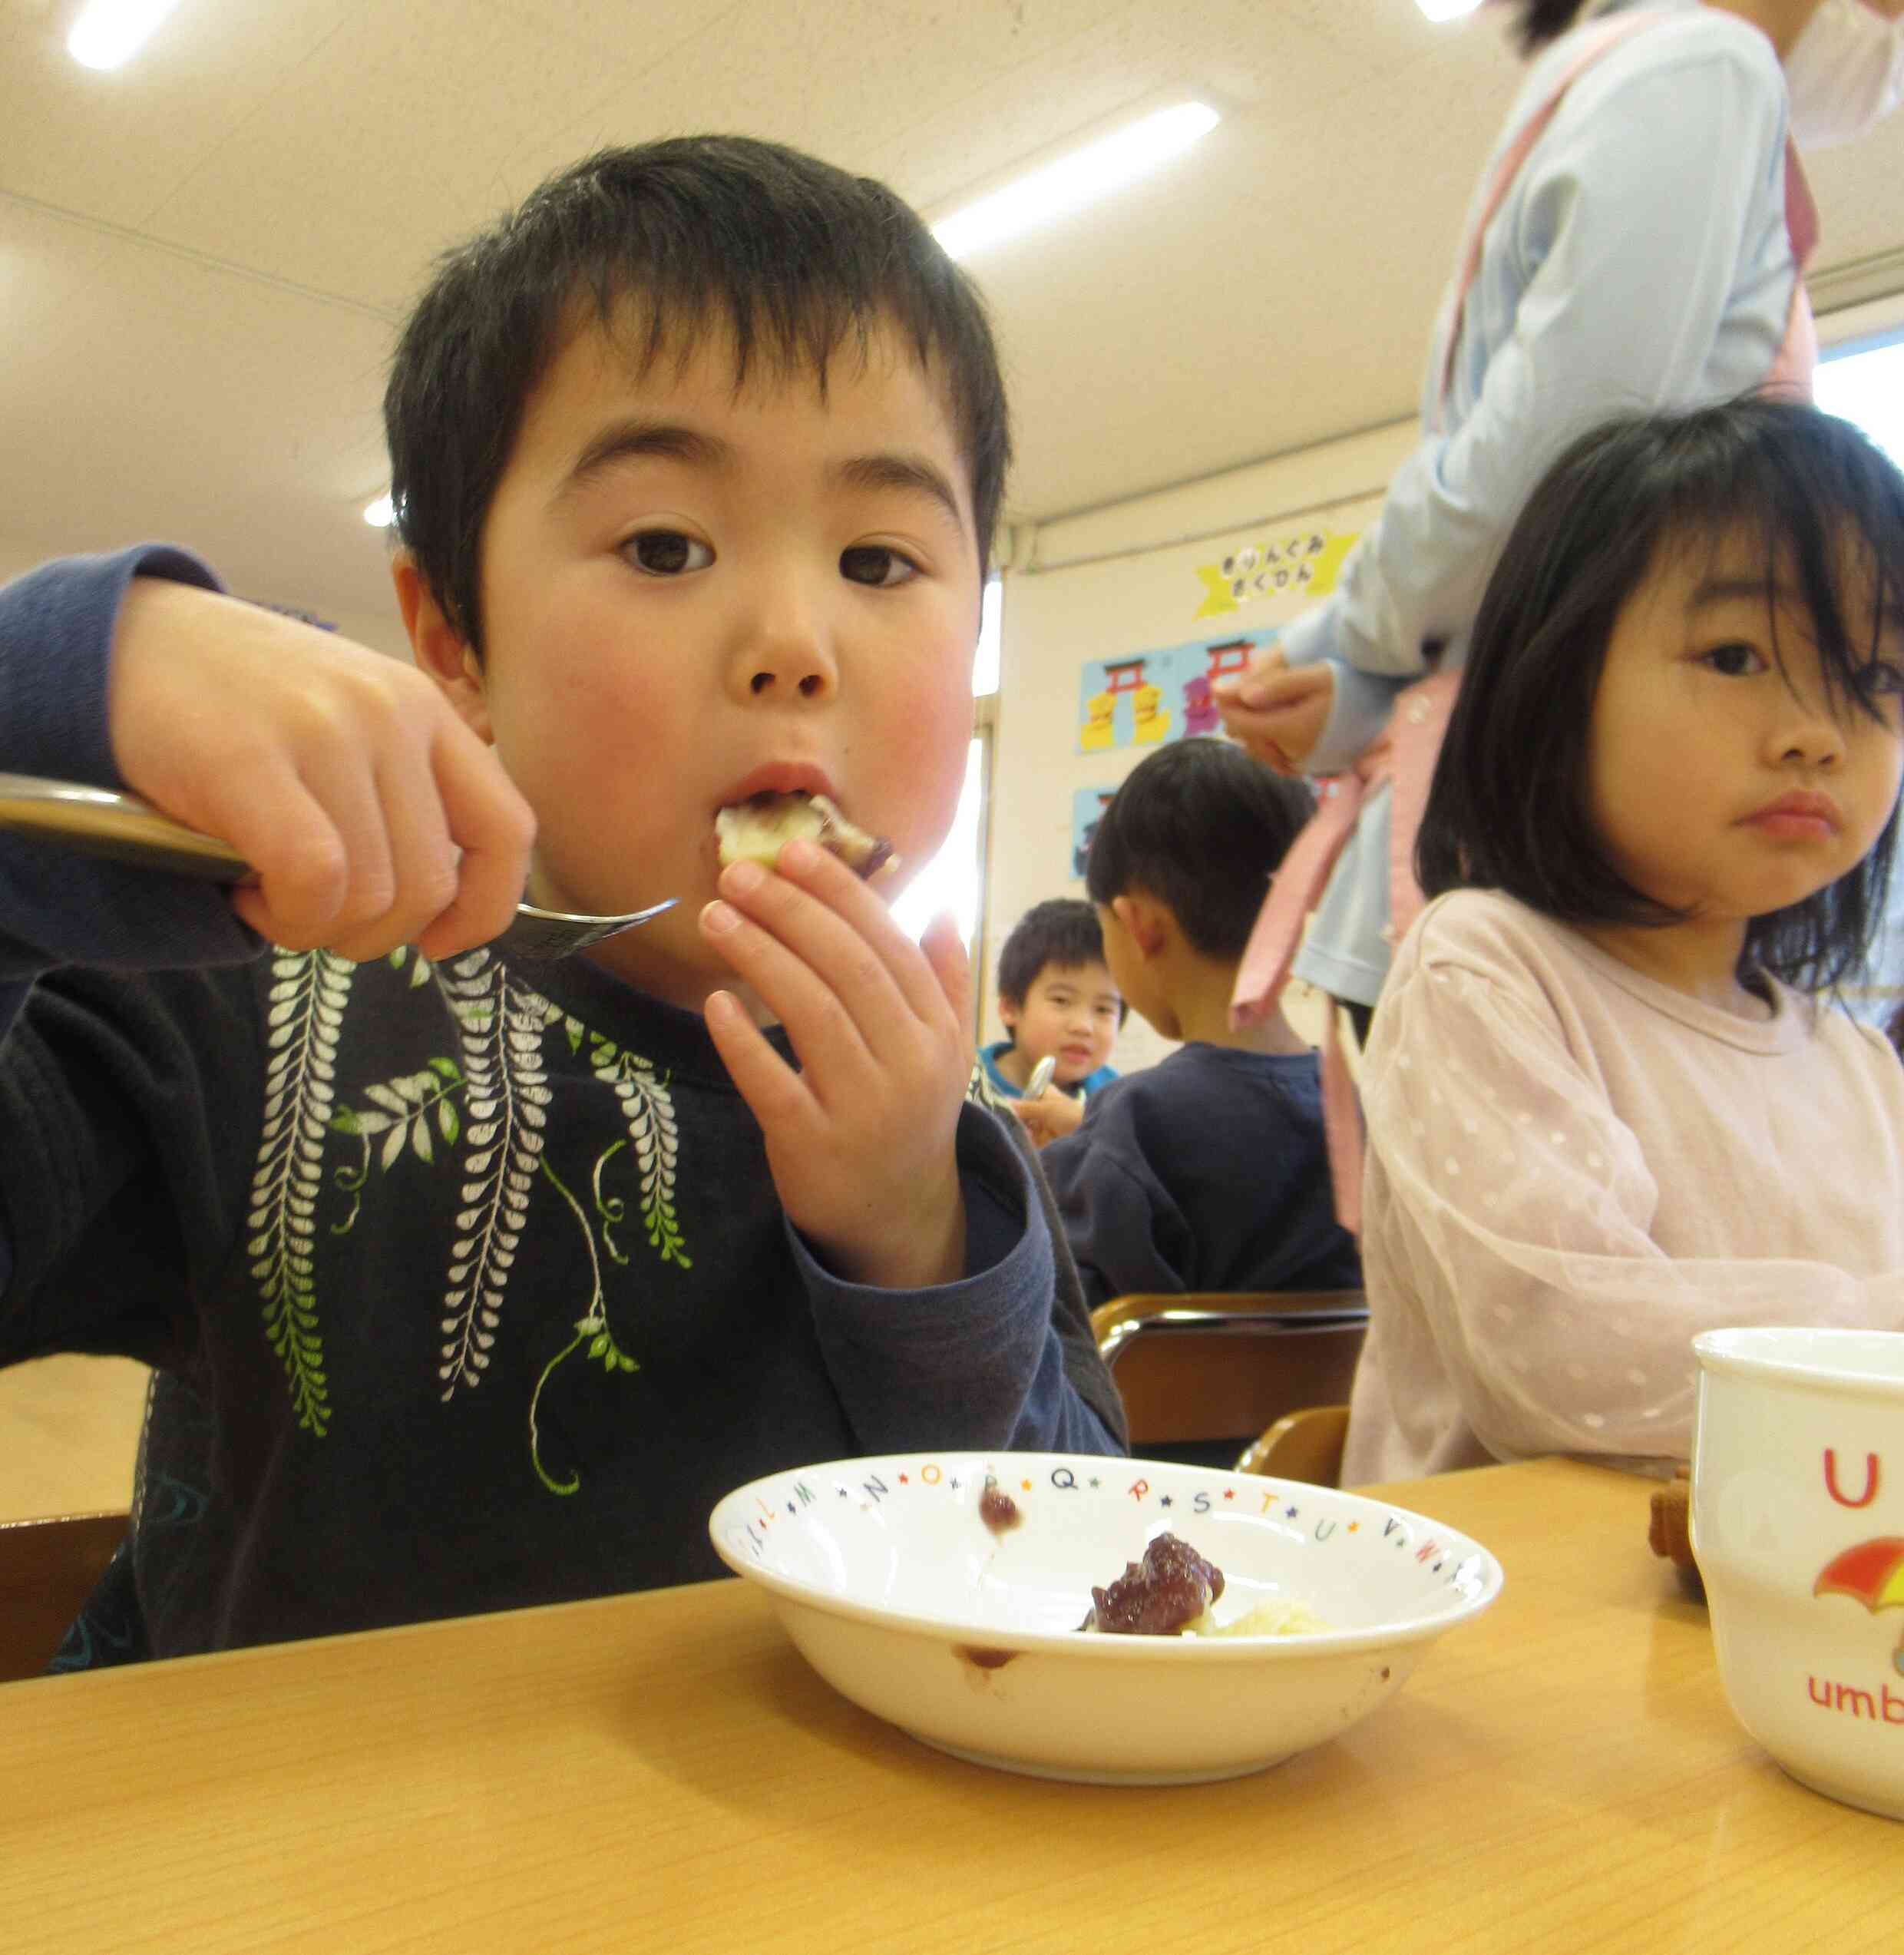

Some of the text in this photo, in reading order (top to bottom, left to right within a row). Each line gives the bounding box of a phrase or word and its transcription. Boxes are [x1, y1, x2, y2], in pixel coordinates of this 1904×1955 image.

[863, 1475, 888, 1502] N
[921, 1464, 940, 1484] O
[1051, 1468, 1079, 1490] Q
[1128, 1479, 1149, 1501] R
[1193, 1492, 1211, 1513] S
[1261, 1493, 1280, 1513] T
[1315, 1519, 1337, 1541] U
[1823, 1449, 1879, 1509] U
